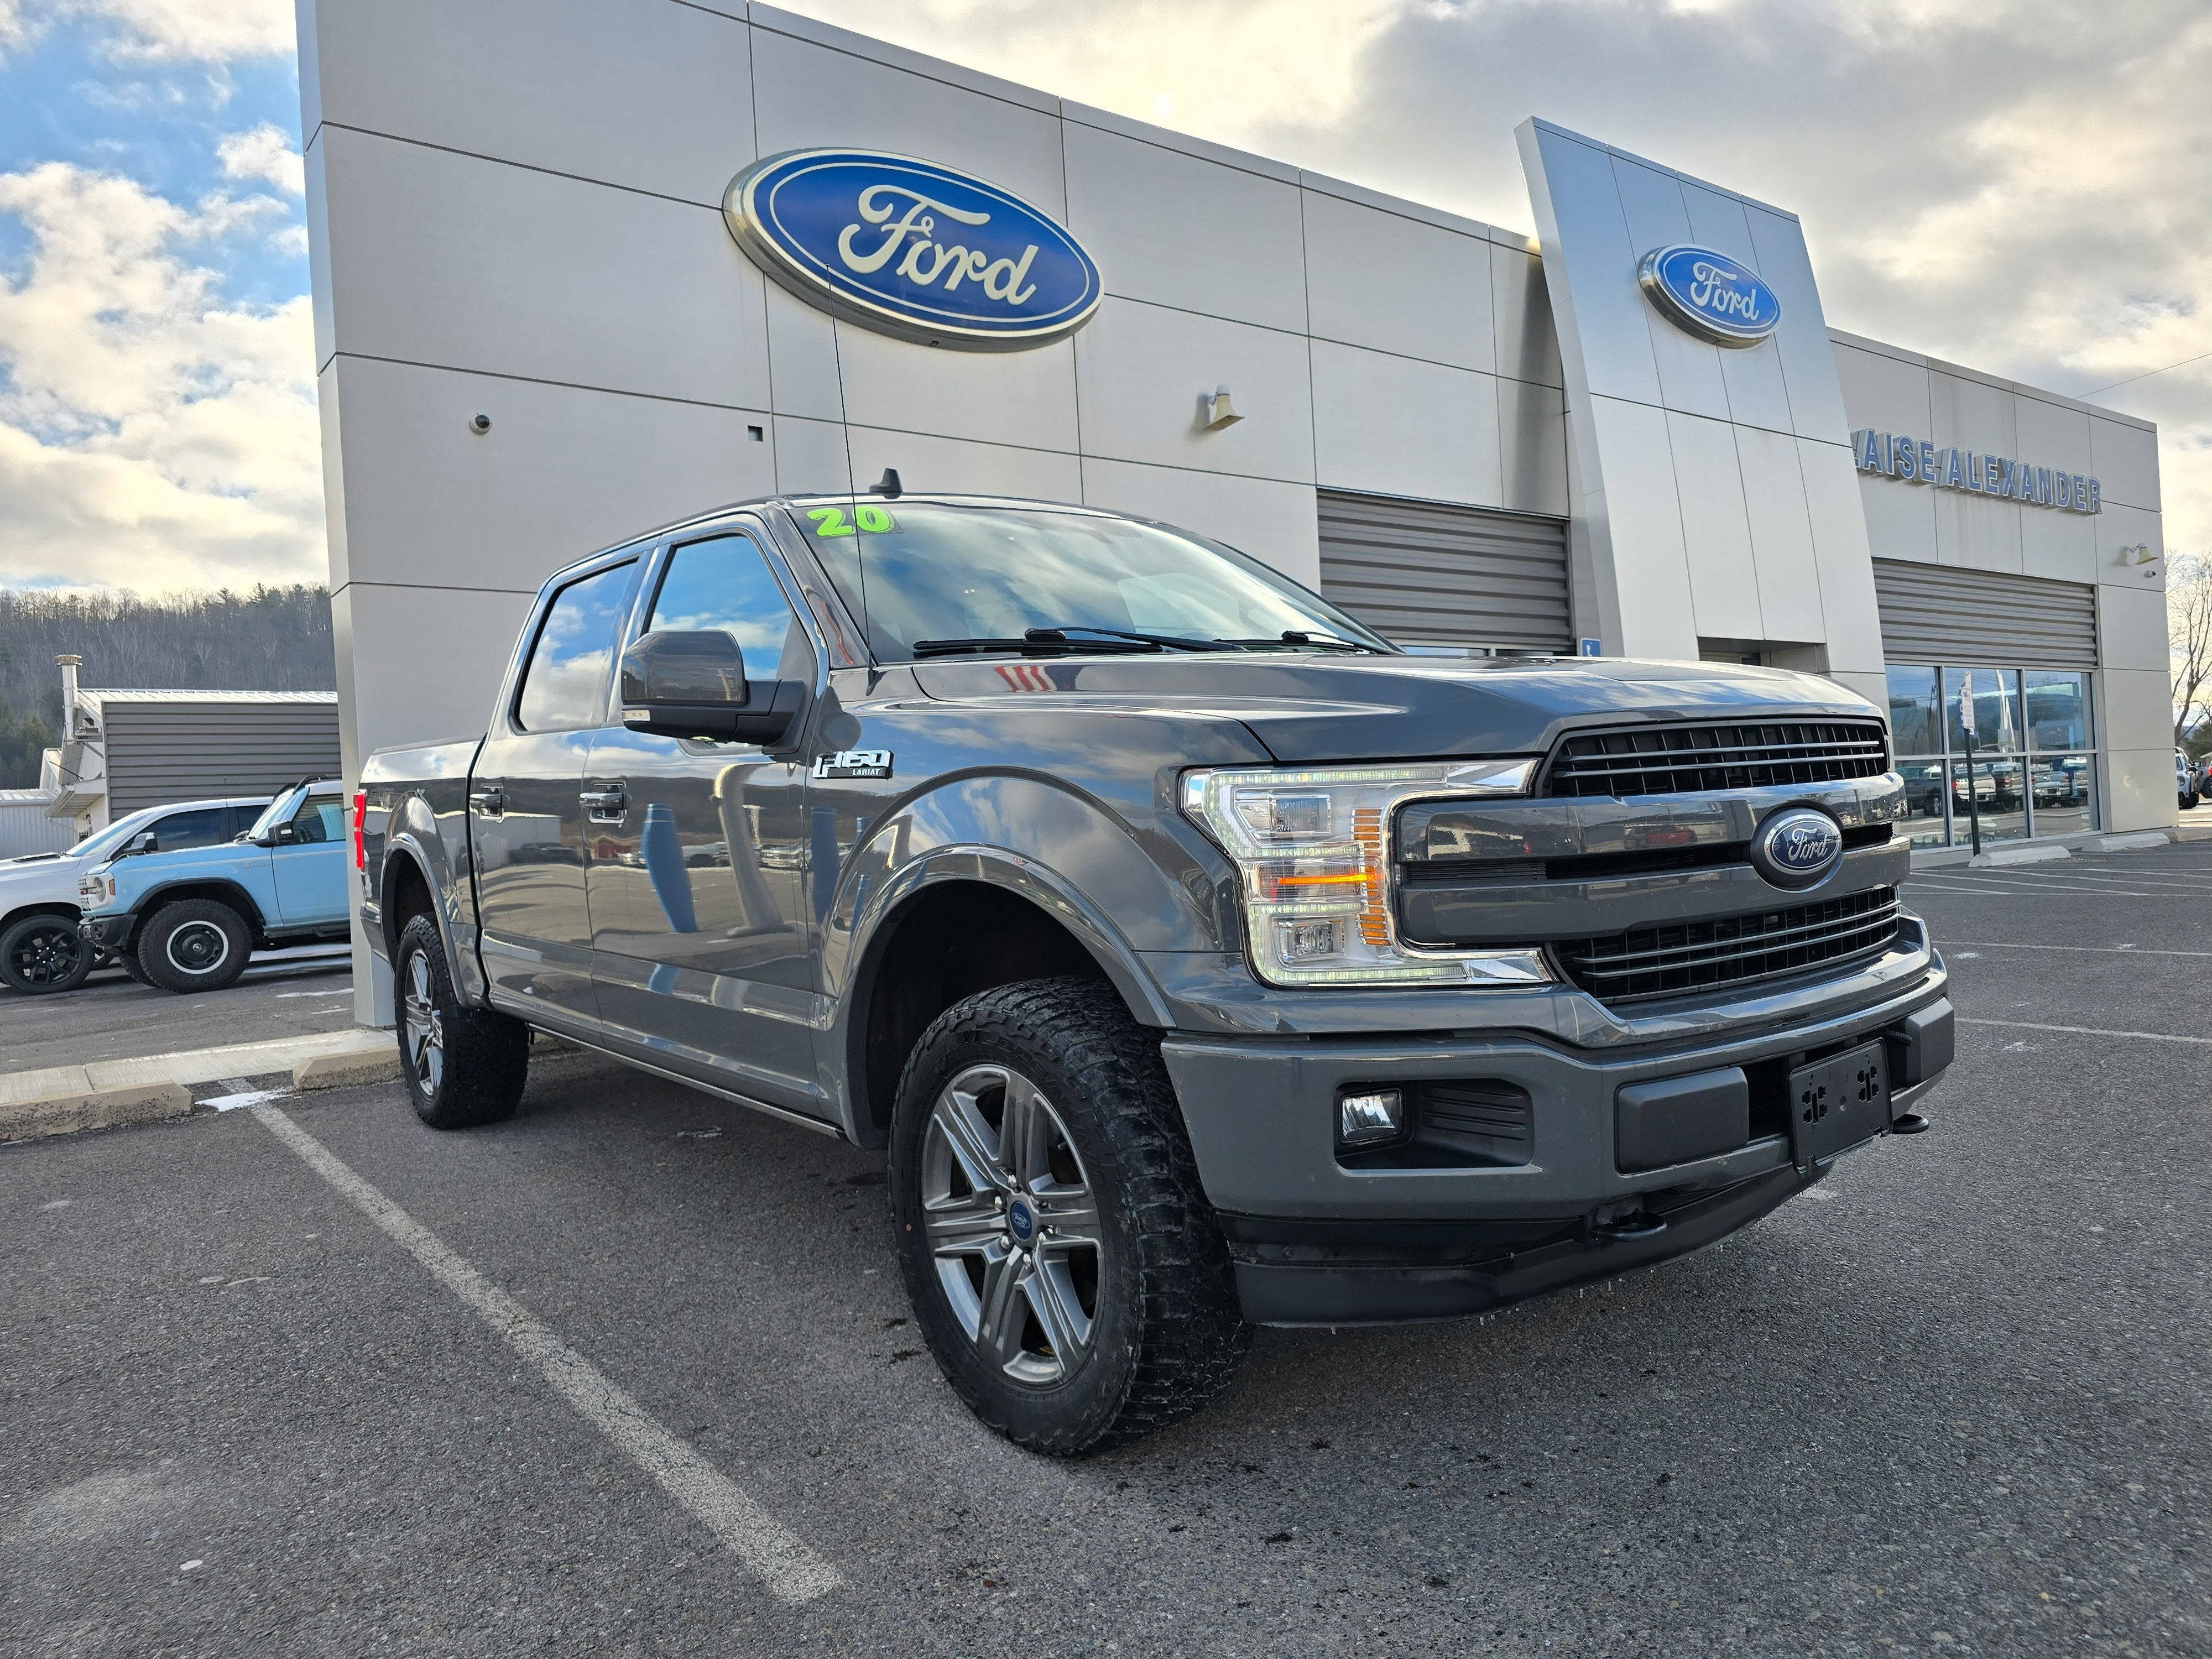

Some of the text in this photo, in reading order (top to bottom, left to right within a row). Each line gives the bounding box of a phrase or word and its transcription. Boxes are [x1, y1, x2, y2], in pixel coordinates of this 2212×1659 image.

[838, 185, 1039, 305] Ford
[1691, 262, 1760, 320] Ford
[1853, 428, 2103, 514] AISE ALEXANDER
[806, 505, 894, 536] 20
[1788, 827, 1828, 862] Ford
